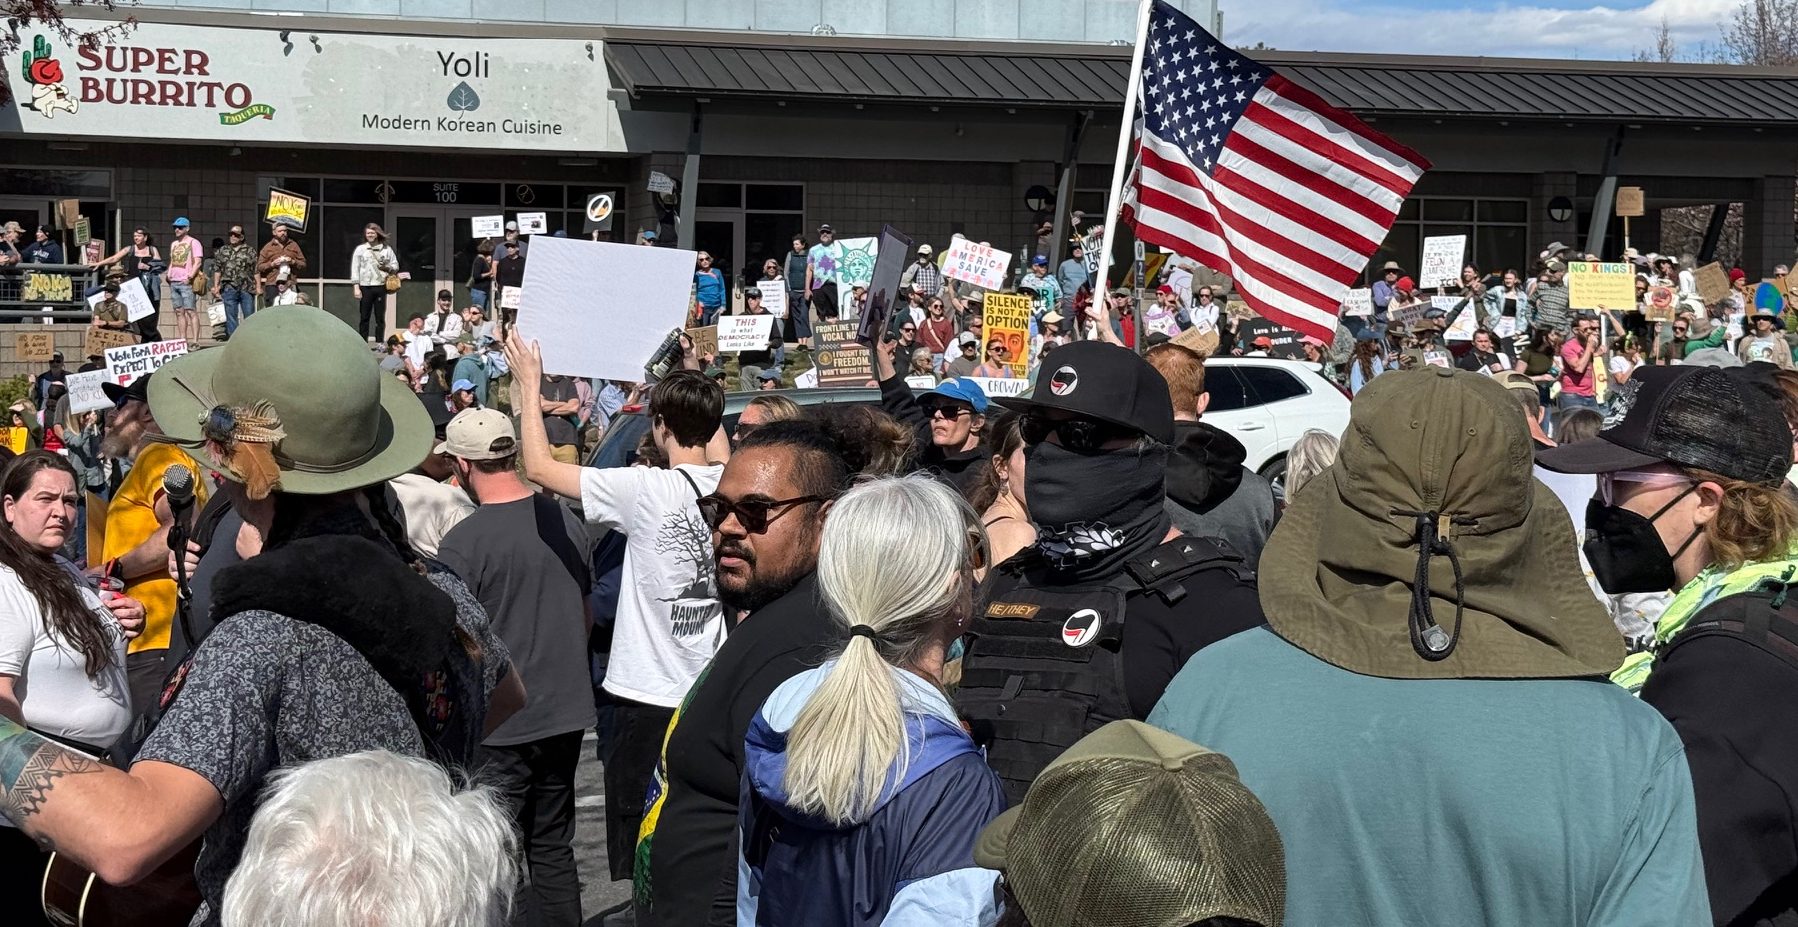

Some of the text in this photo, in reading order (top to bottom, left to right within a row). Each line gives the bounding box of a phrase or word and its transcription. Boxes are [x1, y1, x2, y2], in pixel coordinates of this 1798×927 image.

[76, 45, 210, 76] SUPER
[437, 51, 489, 78] Yoli
[79, 76, 253, 109] BURRITO
[223, 106, 271, 124] TAQUERIA
[362, 114, 563, 135] Modern Korean Cuisine
[433, 183, 459, 191] SUITE
[435, 191, 457, 203] 100
[964, 242, 993, 258] LOVE
[951, 249, 1003, 271] AMERICA
[958, 261, 988, 277] SAVE
[1571, 263, 1587, 273] NO
[987, 295, 1030, 310] SILENCE
[986, 306, 1030, 318] IS NOT AN
[735, 319, 756, 327] THIS
[986, 314, 1029, 330] OPTION
[694, 330, 708, 343] BE
[815, 325, 849, 334] FRONTLINE
[822, 332, 845, 341] VOCAL
[151, 340, 187, 355] RAPIST
[833, 356, 871, 367] FREEDOM.
[988, 380, 1025, 394] CROWN
[988, 604, 1036, 615] HE/THEY
